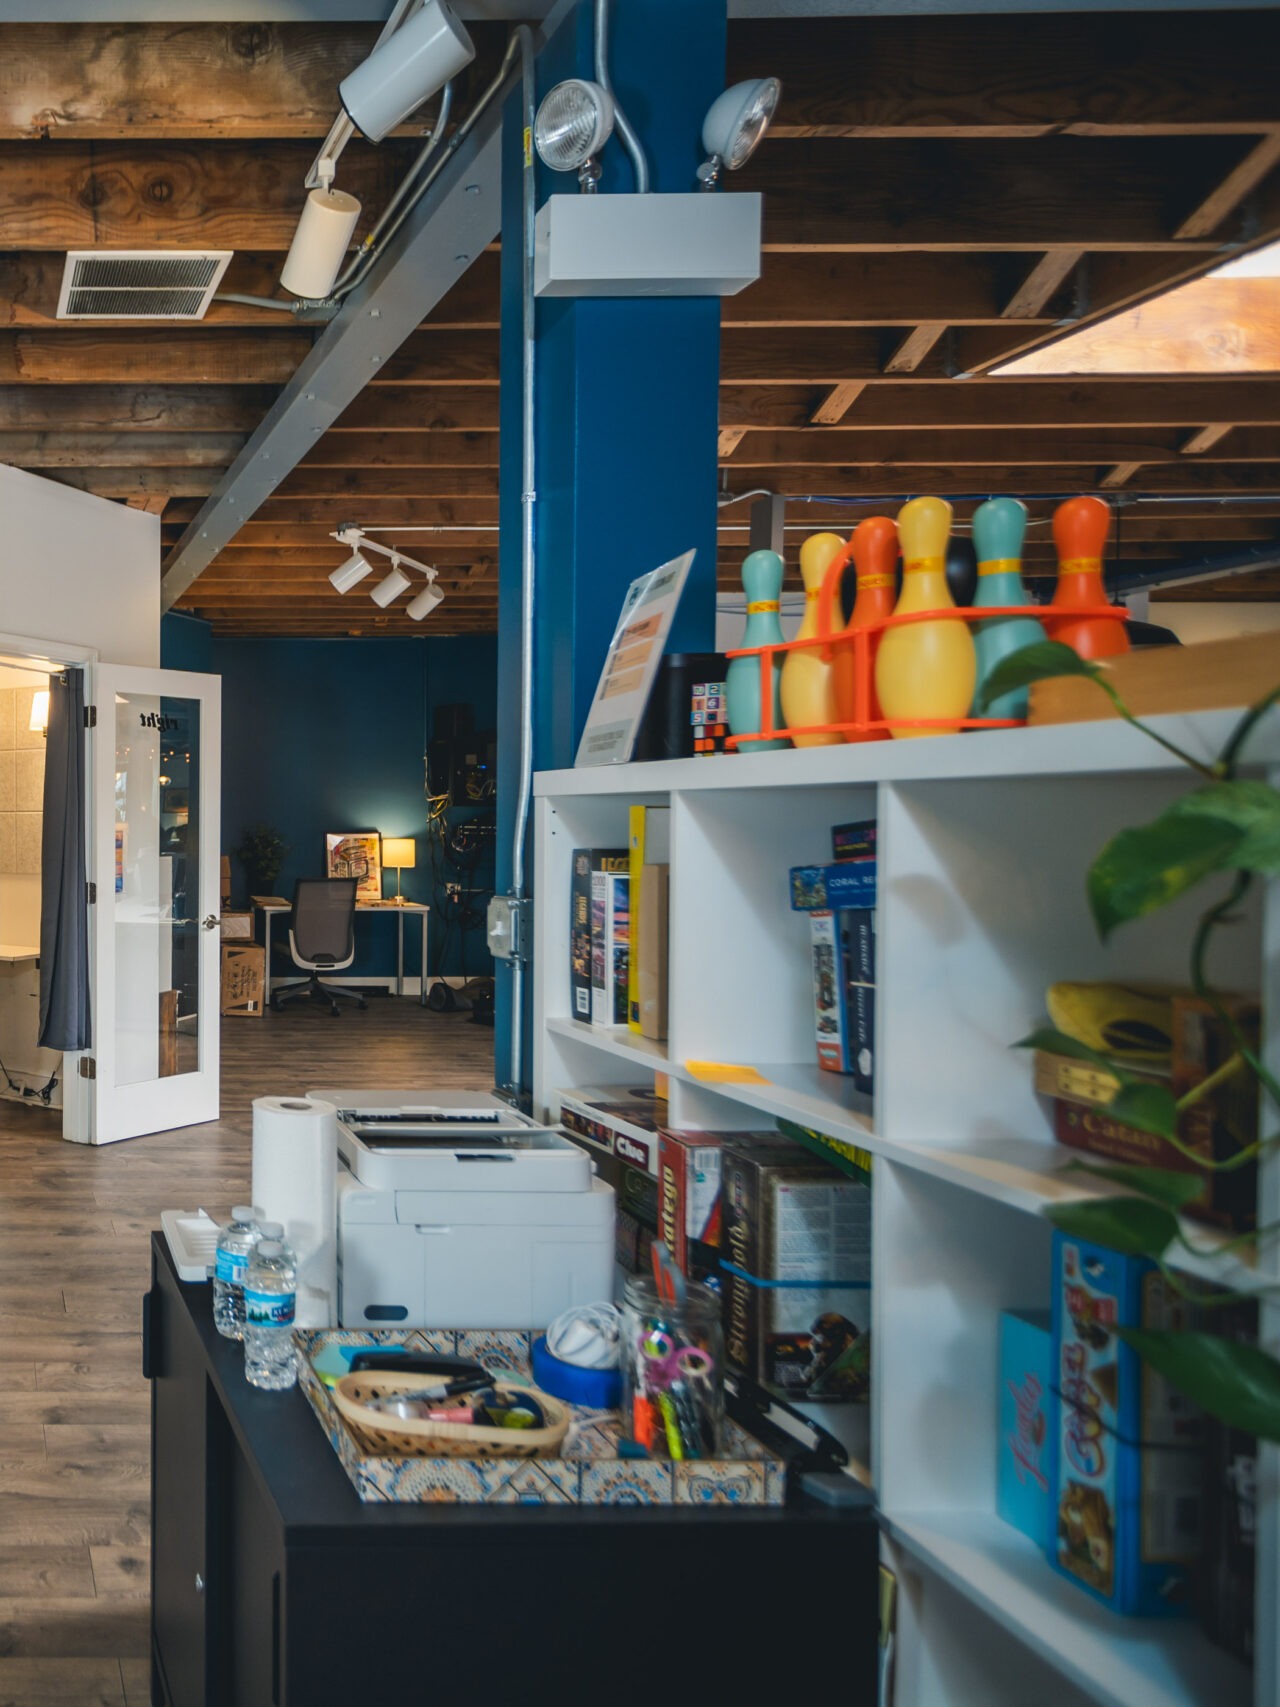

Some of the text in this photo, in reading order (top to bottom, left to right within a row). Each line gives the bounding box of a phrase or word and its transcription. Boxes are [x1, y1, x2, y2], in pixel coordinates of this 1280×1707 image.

[829, 877, 860, 888] CORAL
[1082, 1113, 1161, 1151] Catan
[616, 1135, 646, 1164] Clue
